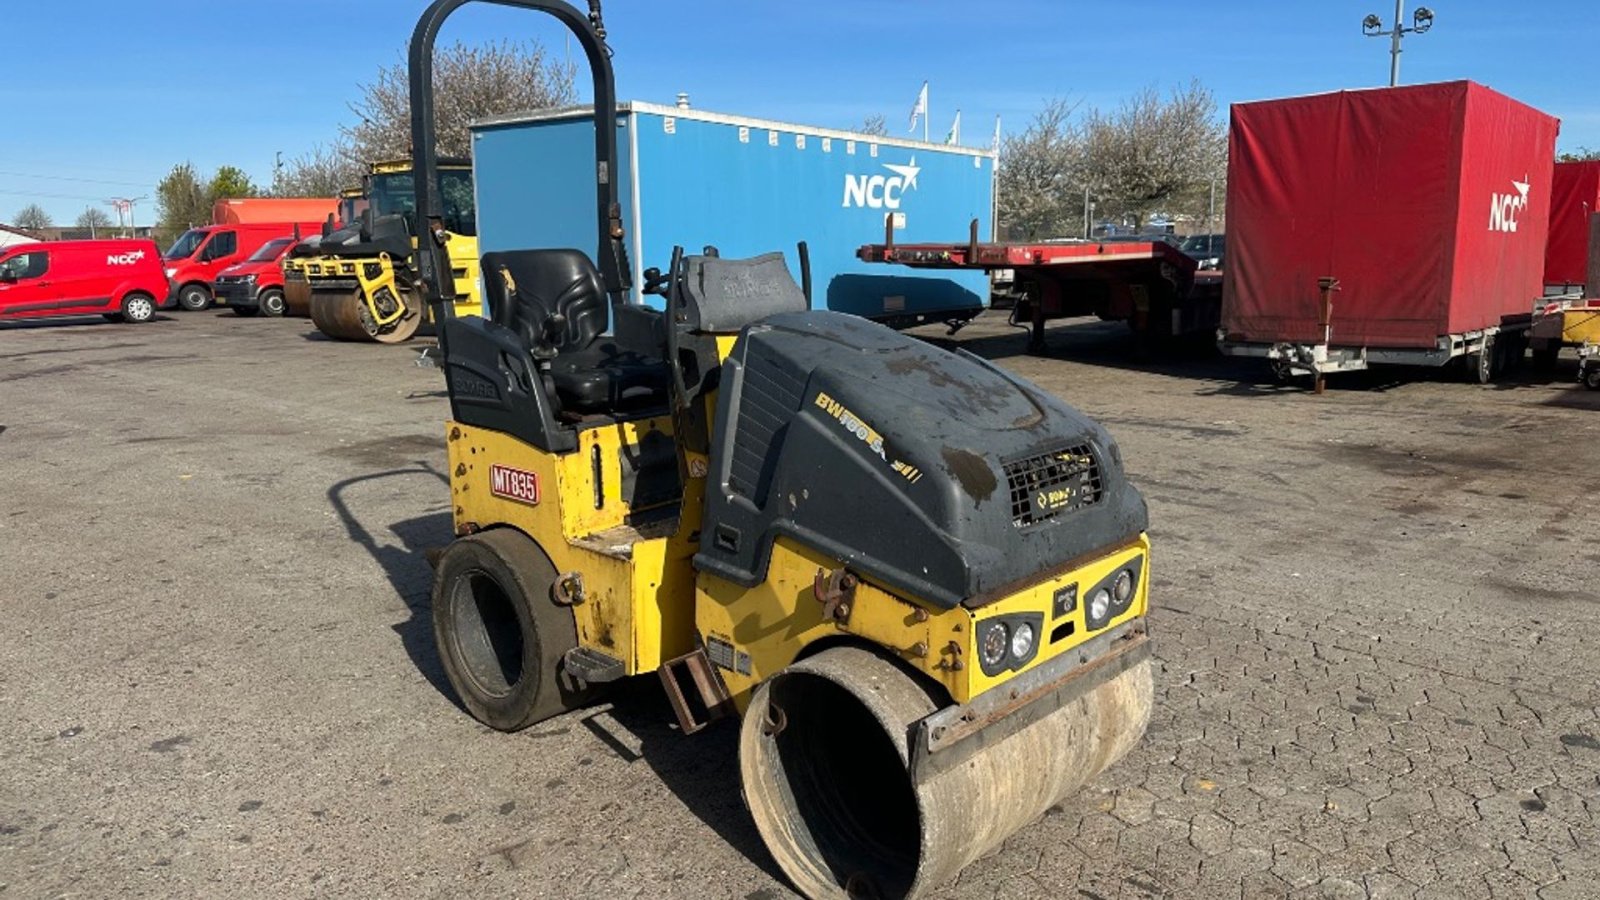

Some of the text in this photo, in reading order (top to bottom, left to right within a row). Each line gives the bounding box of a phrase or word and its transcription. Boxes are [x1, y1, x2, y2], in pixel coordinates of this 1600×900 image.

[843, 174, 901, 208] NCC
[1488, 192, 1520, 232] NCC
[107, 255, 136, 265] NCC
[493, 467, 535, 500] MT835
